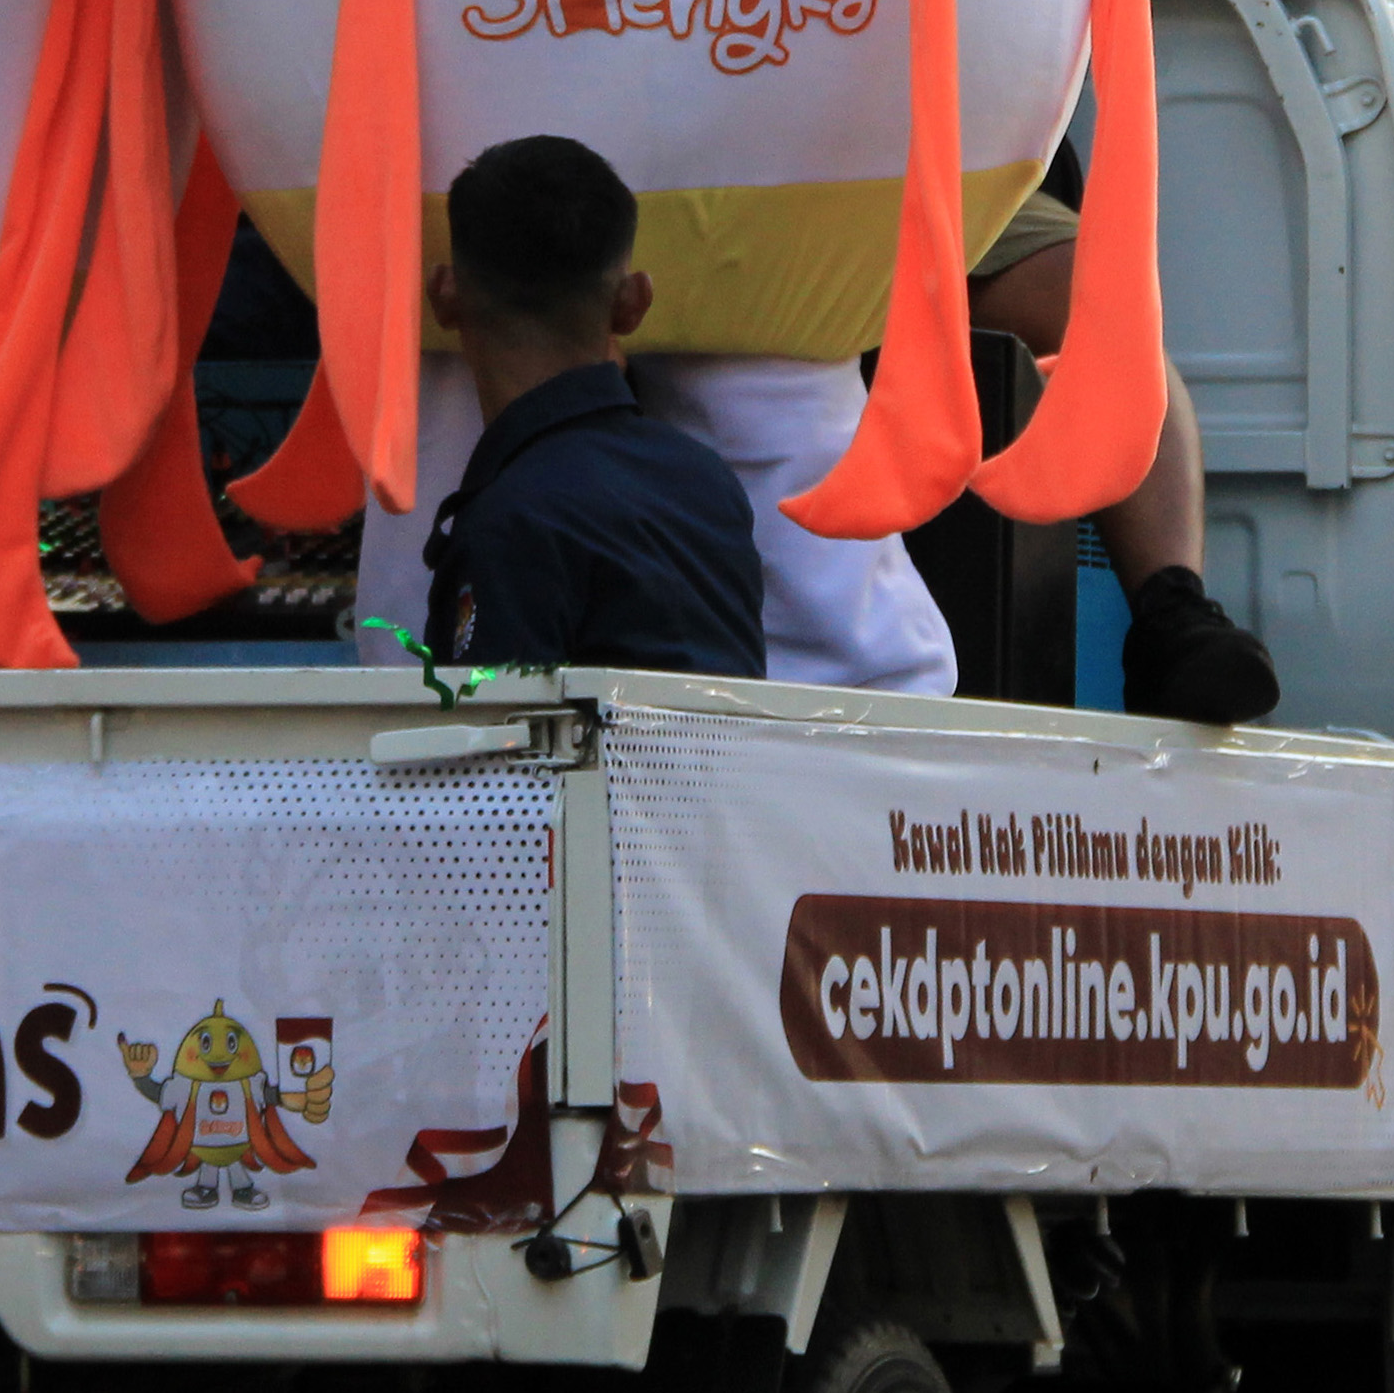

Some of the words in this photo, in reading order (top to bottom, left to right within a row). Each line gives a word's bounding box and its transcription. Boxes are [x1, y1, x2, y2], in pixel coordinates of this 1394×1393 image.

[889, 808, 973, 875] Kawal
[977, 811, 1027, 877] Hak
[1031, 812, 1130, 881] Pilihmu
[1136, 815, 1224, 900] dengan
[1227, 821, 1282, 886] Klik:
[819, 926, 1348, 1072] cekdptonline.kpu.go.id
